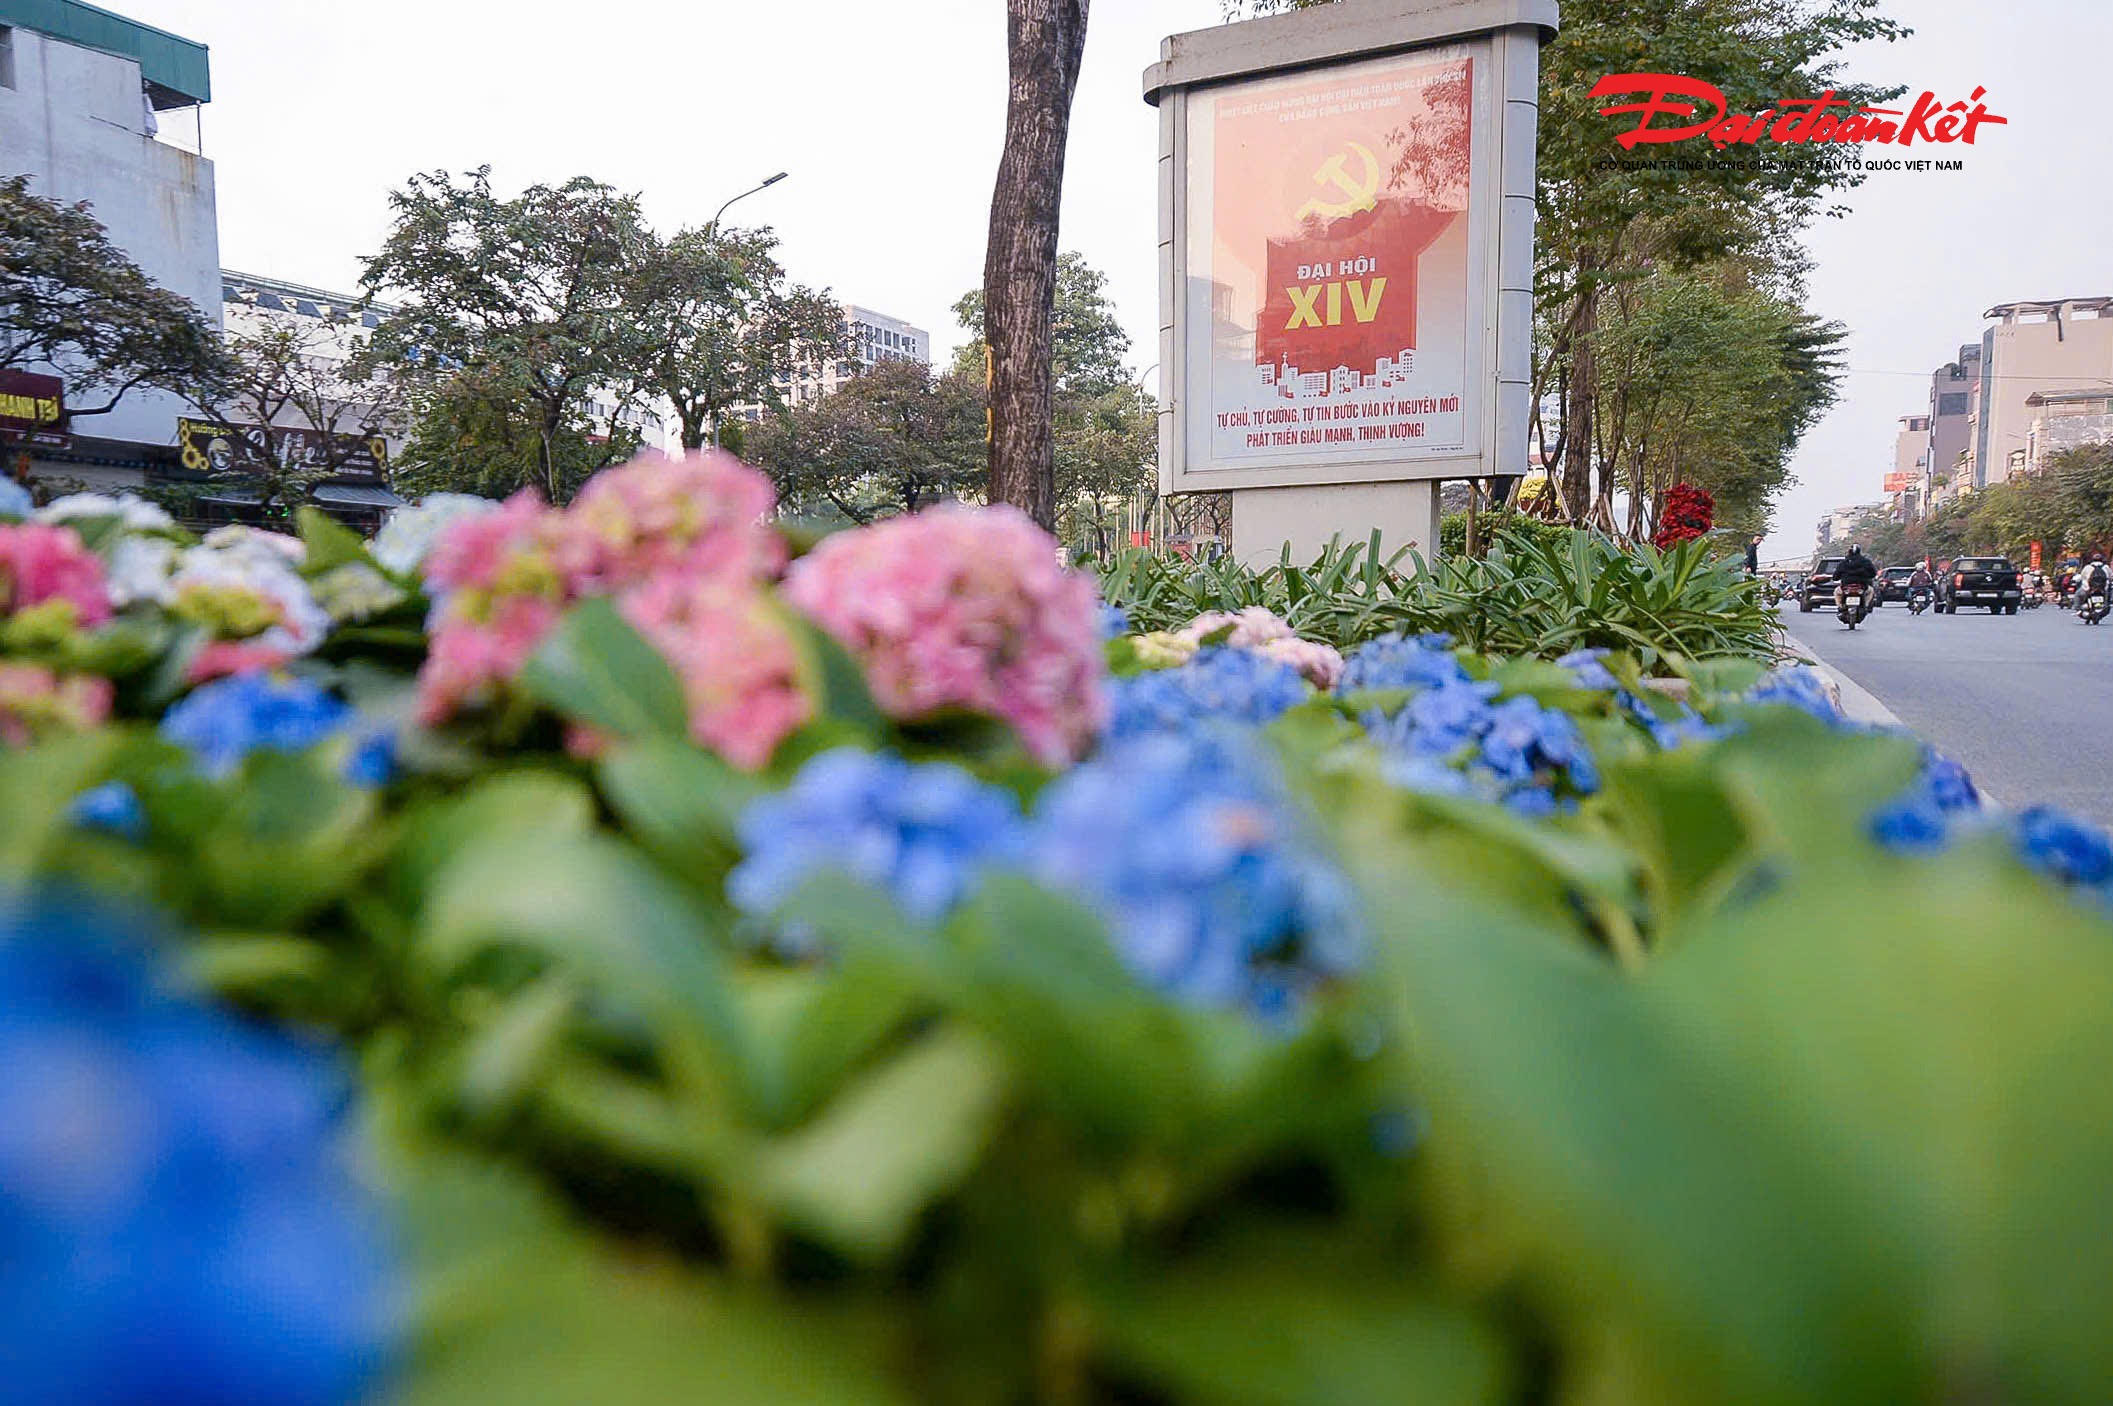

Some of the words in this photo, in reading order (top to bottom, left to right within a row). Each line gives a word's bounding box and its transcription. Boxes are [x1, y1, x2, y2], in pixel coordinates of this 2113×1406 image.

[1297, 262, 1332, 281] ĐẠI
[1340, 255, 1376, 276] HỘI
[1285, 276, 1387, 330] XIV
[1217, 412, 1229, 430] TỰ
[1303, 406, 1315, 425] TỰ
[1316, 405, 1331, 420] TIN
[1334, 400, 1358, 419] BƯỚC
[1398, 395, 1436, 415] NGUYÊN
[1440, 393, 1459, 412] MỚI
[1247, 429, 1269, 448] PHÁT
[1359, 425, 1386, 443] THỊNH
